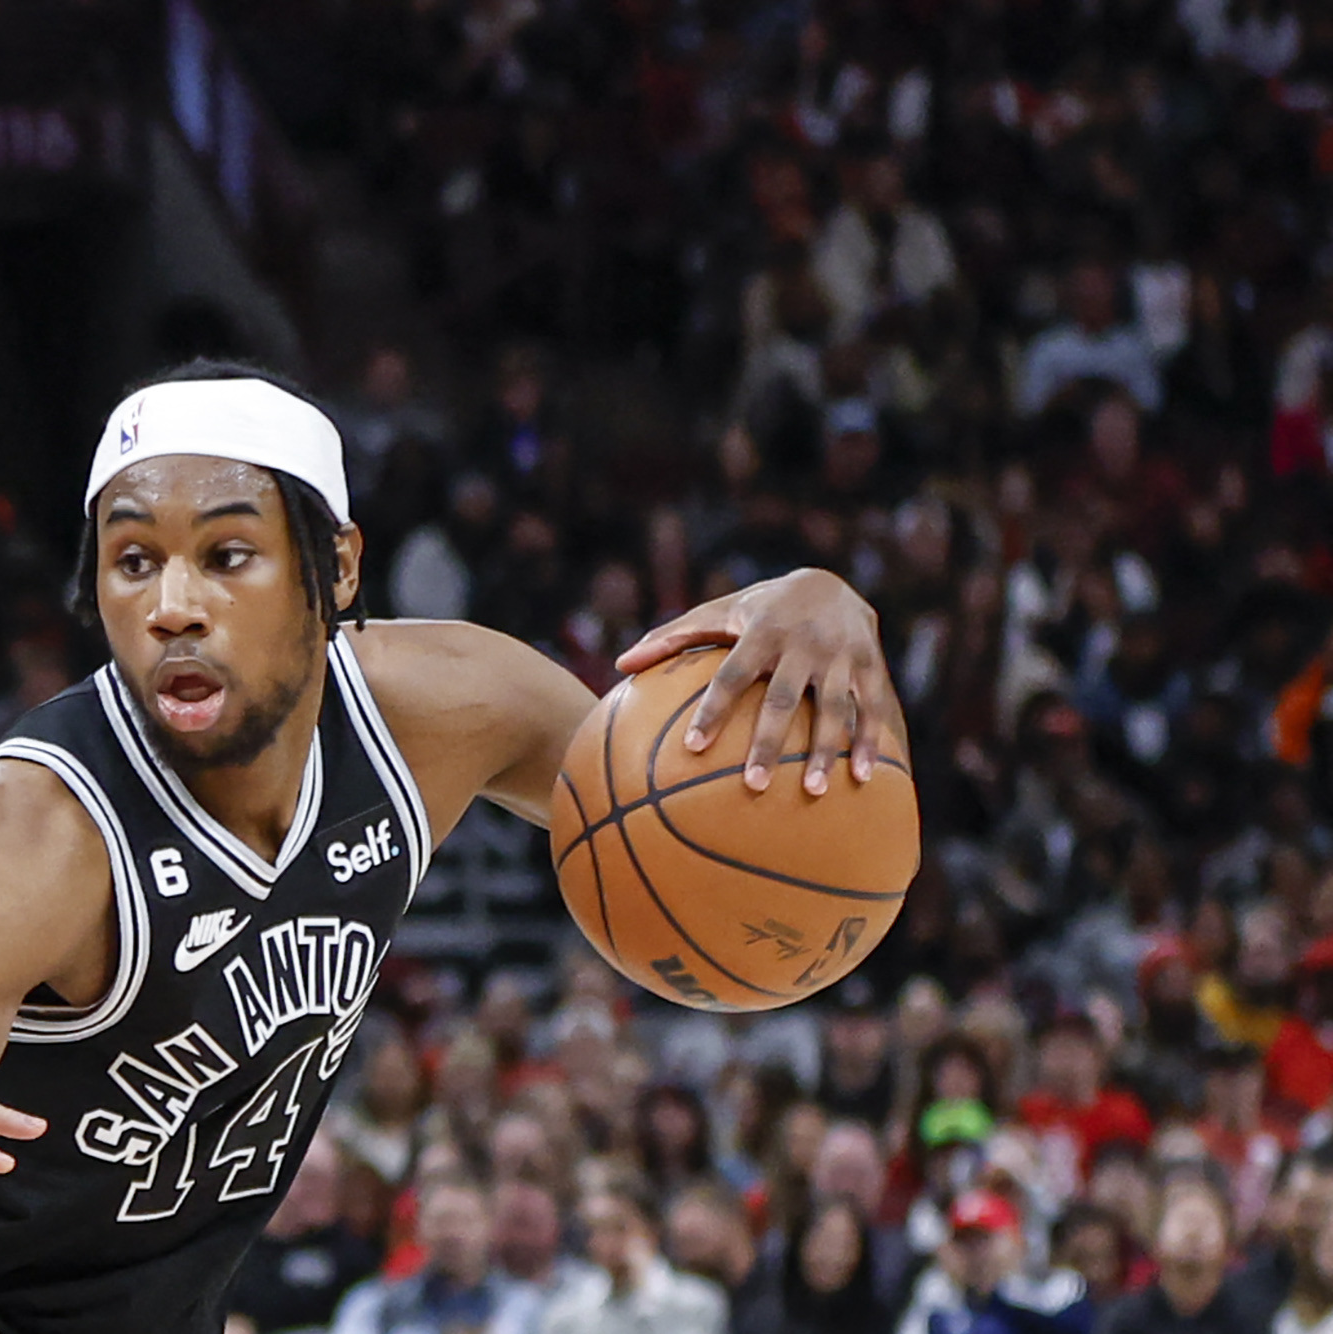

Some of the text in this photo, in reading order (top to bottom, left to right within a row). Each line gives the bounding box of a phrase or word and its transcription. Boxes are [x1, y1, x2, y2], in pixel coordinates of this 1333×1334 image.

[149, 847, 191, 897] 6
[185, 907, 237, 949] NIKE
[74, 916, 390, 1166] SAN ANTO
[116, 1036, 325, 1222] 14
